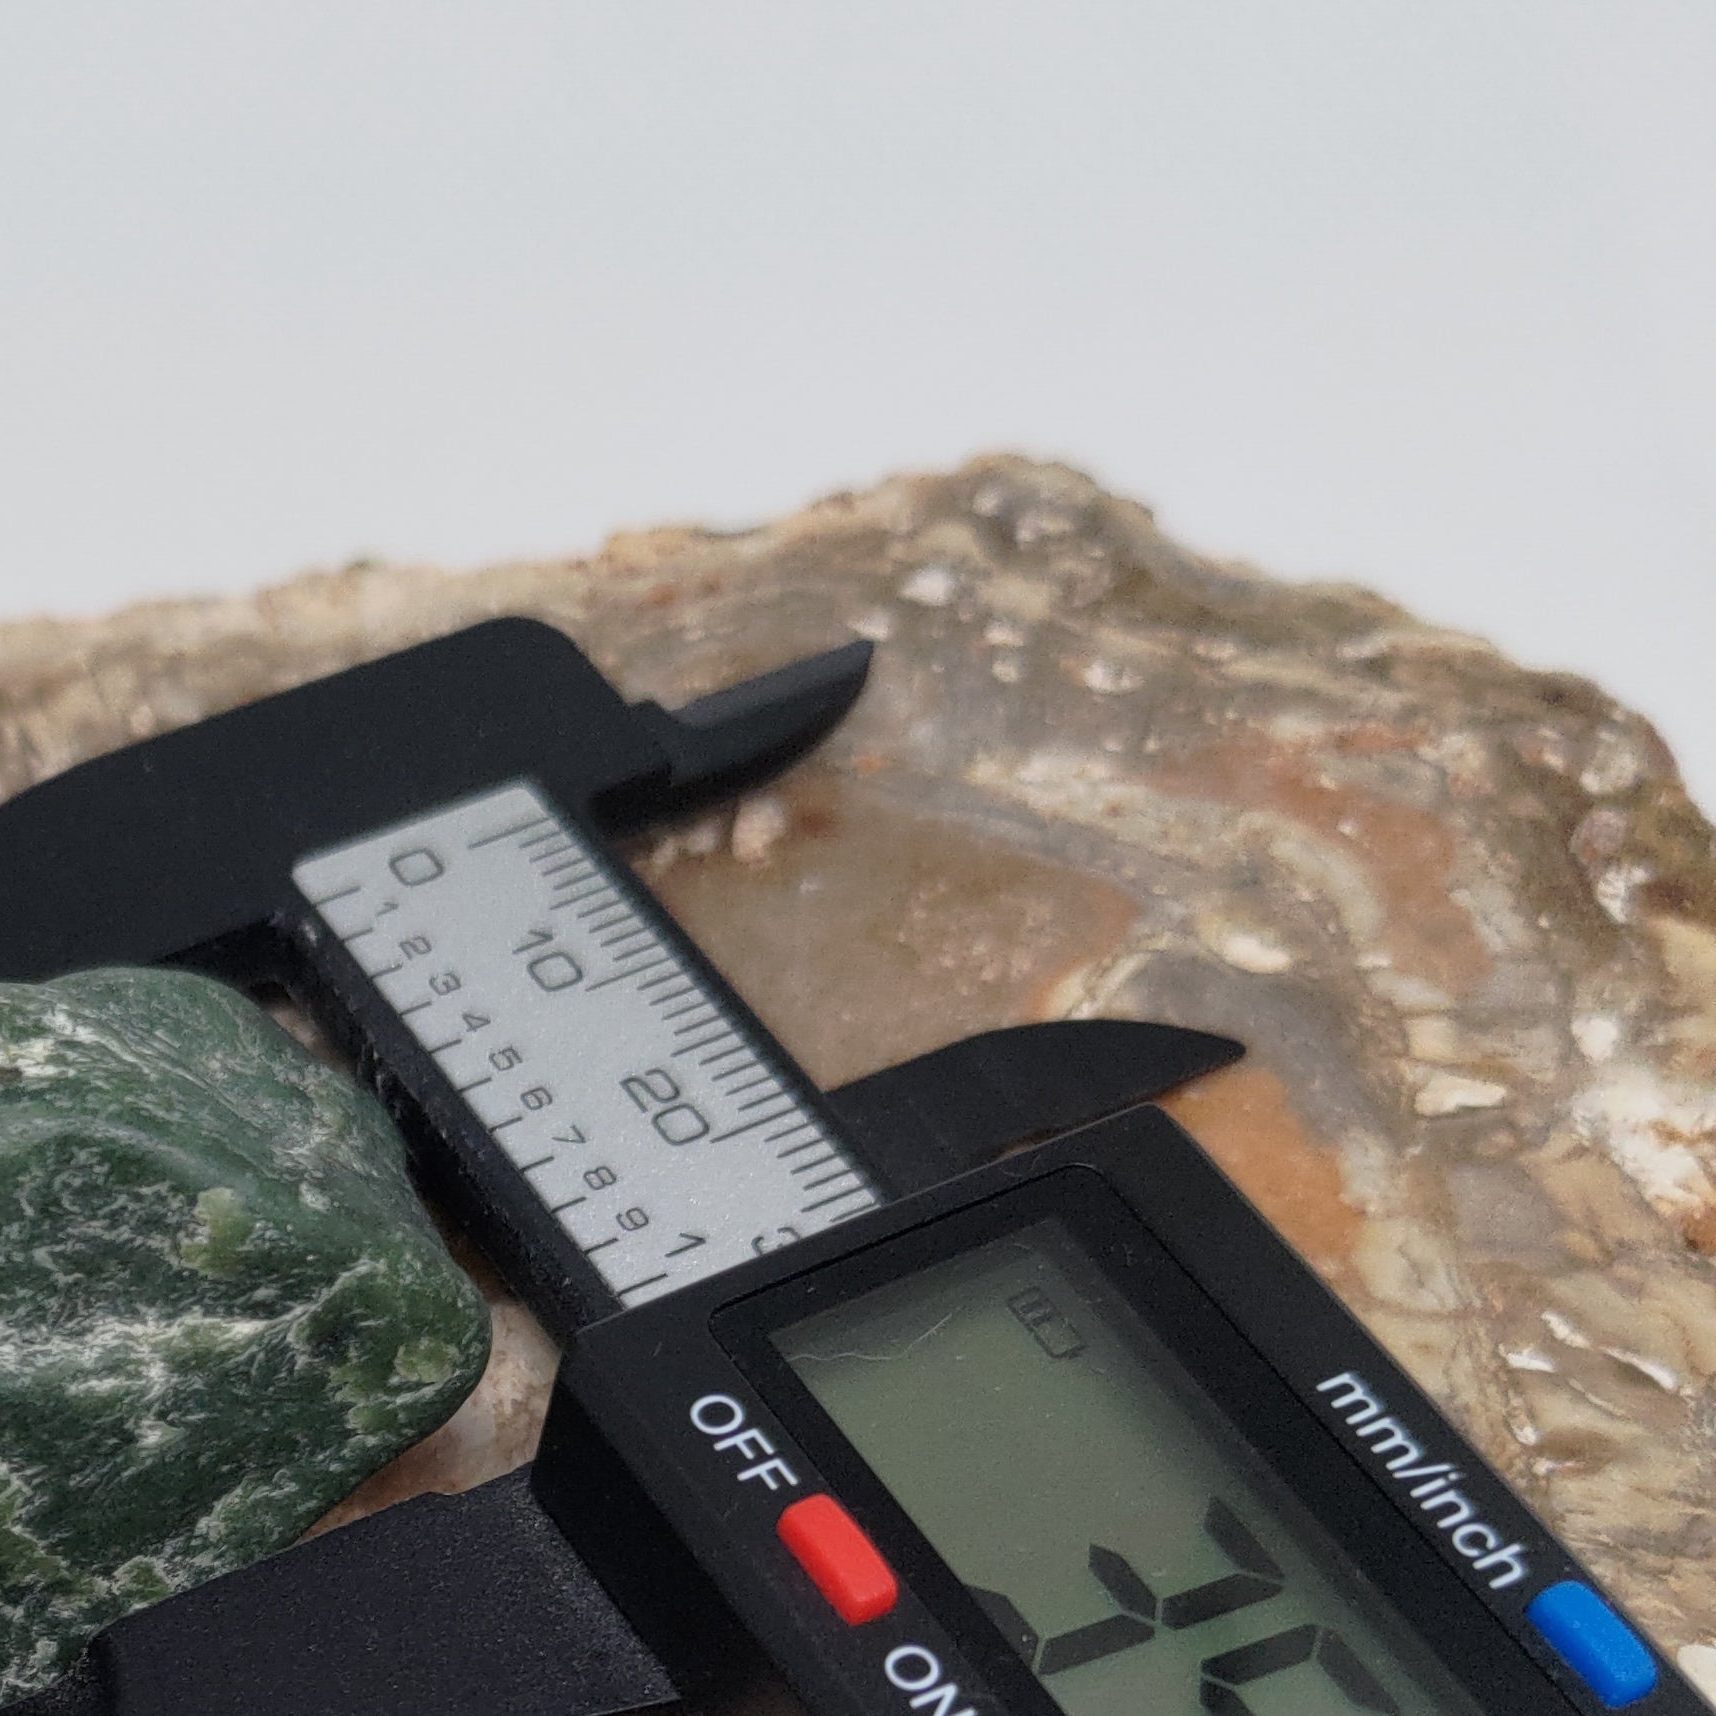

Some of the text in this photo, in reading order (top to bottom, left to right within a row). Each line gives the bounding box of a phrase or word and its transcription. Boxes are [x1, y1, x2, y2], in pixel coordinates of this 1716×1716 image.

[389, 847, 709, 1146] 0 10 20
[399, 935, 431, 959] 2
[429, 970, 461, 996] 3
[461, 1009, 491, 1032] 4
[490, 1044, 522, 1071] 5
[520, 1085, 553, 1111] 6
[553, 1124, 586, 1145] 7
[584, 1165, 617, 1190] 8
[616, 1206, 650, 1231] 9
[664, 1232, 707, 1259] 1
[688, 1393, 797, 1493] OFF
[1315, 1371, 1527, 1590] mm/inch
